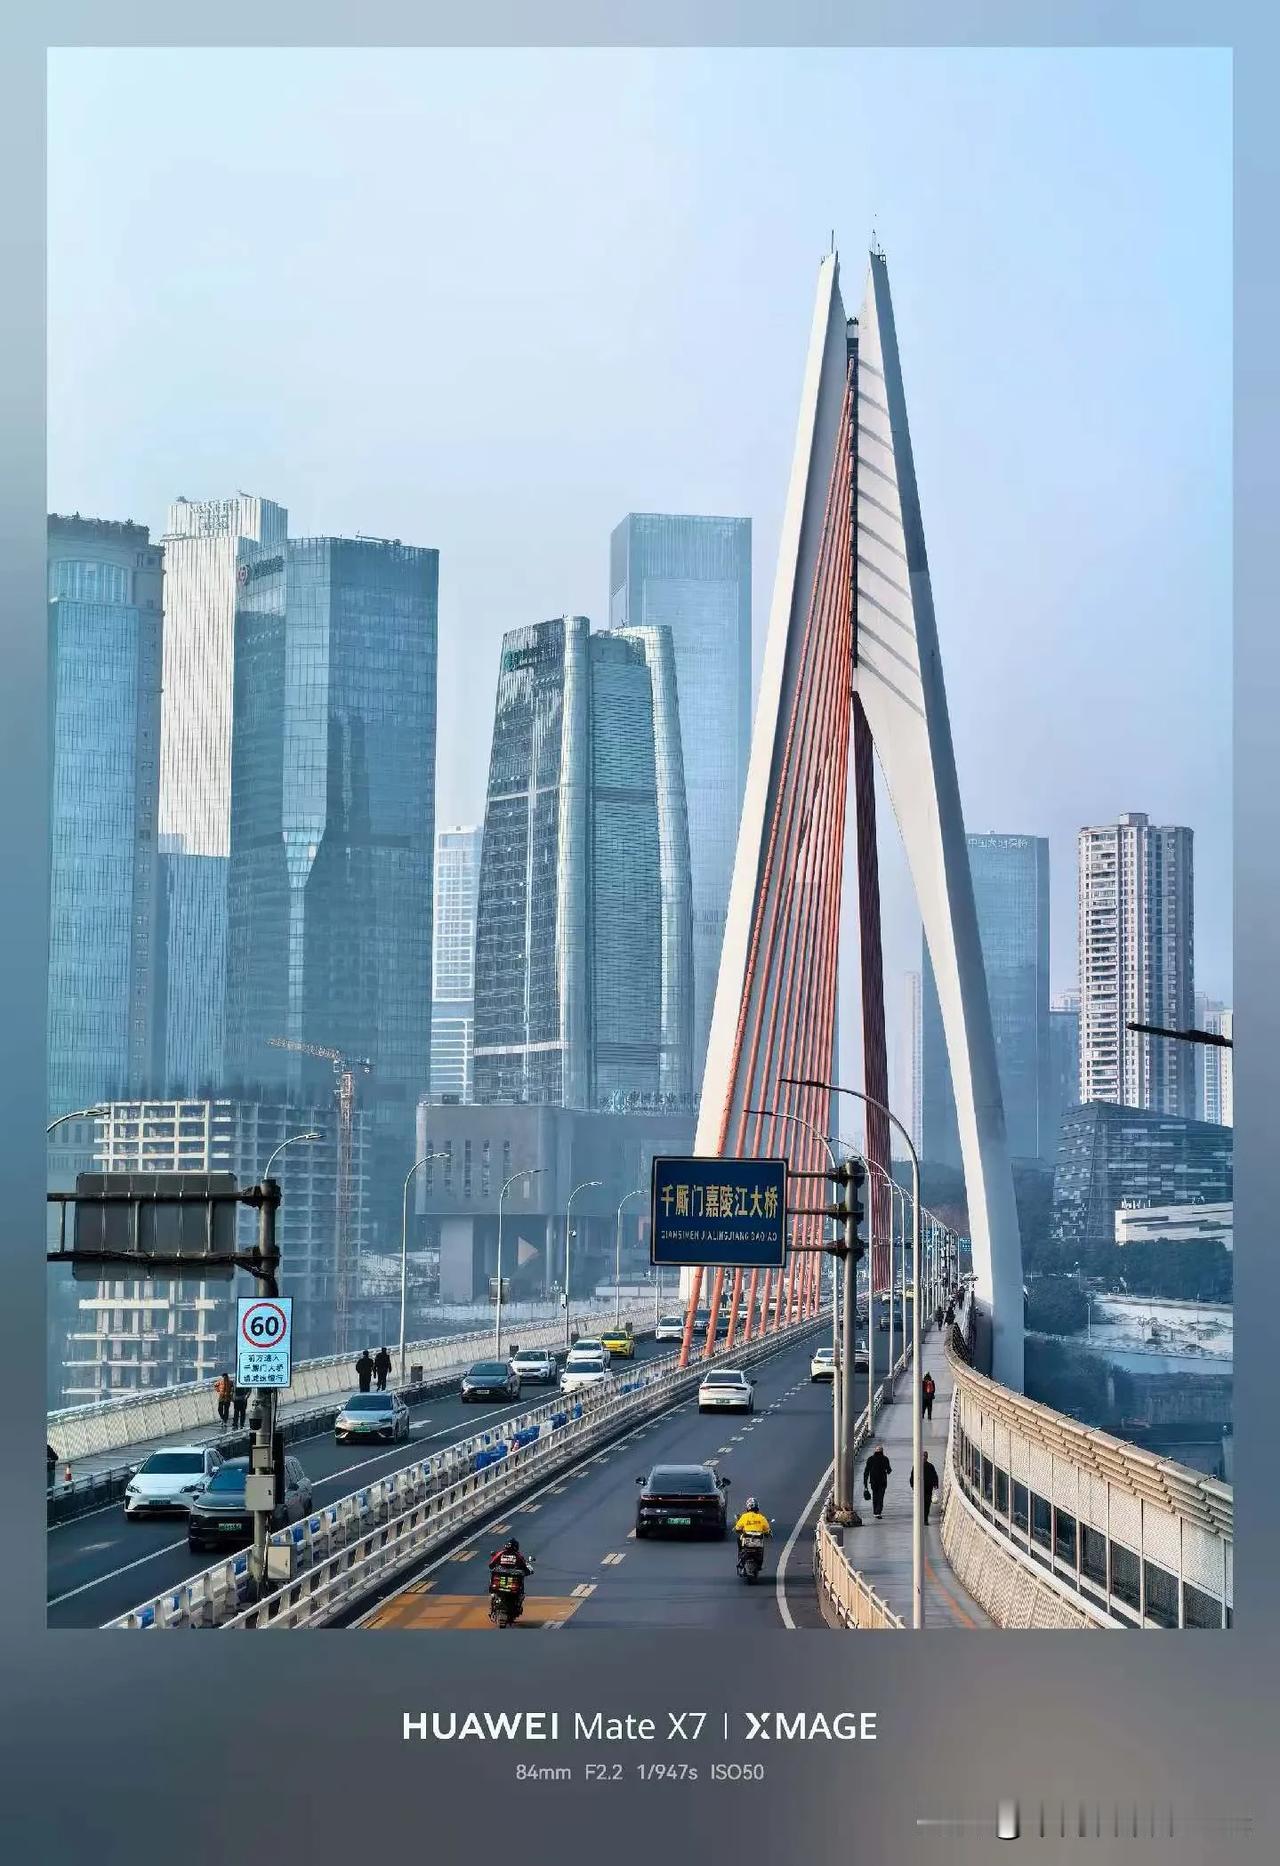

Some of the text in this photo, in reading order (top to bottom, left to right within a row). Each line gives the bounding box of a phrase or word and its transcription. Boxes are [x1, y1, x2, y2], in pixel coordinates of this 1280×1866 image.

[661, 1184, 778, 1218] 千厮门嘉陵江大桥
[251, 1316, 279, 1336] 60
